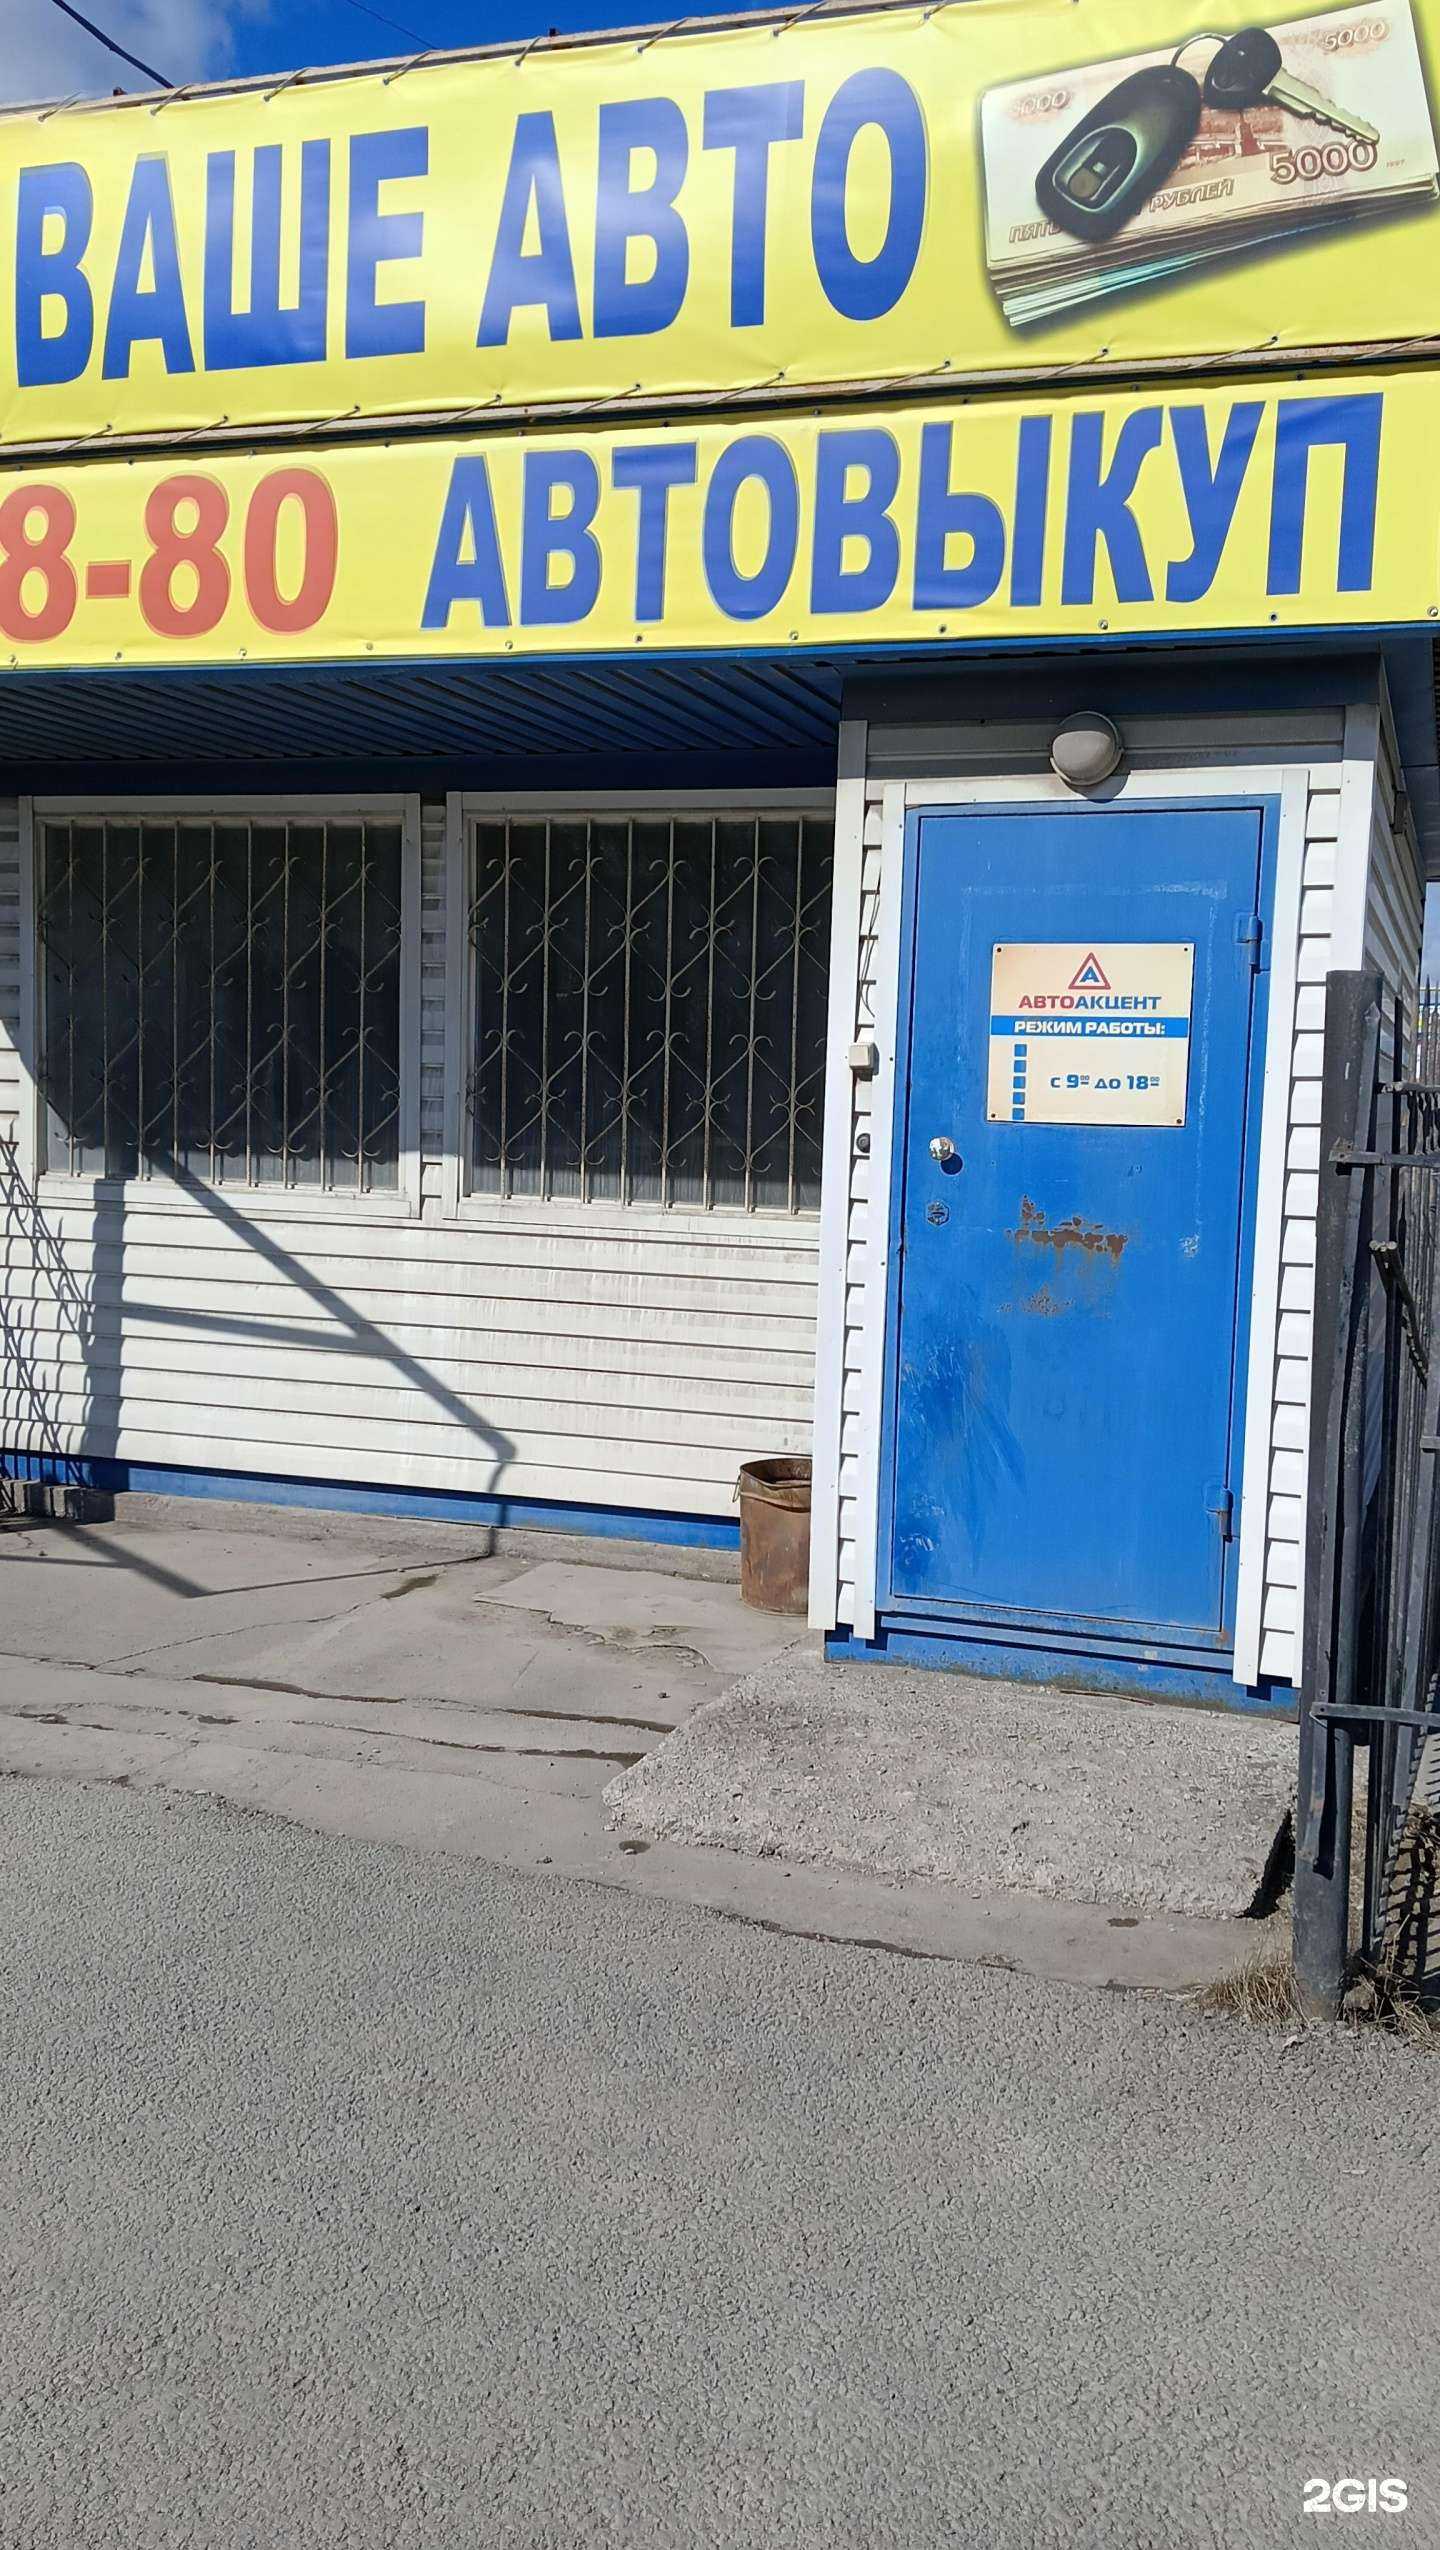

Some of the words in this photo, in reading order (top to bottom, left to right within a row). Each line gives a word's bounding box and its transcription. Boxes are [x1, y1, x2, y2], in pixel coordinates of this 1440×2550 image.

[1269, 141, 1378, 185] 5000
[1149, 177, 1234, 212] РУБЛЕЙ
[15, 126, 429, 388] ВАШЕ
[476, 66, 928, 348] АВТО
[420, 391, 1384, 631] АВТОВЫКУП
[1018, 995, 1162, 1010] АВТОАКЦЕНТ
[1014, 1021, 1082, 1034] РЕЖИМ
[1085, 1021, 1166, 1035] РАБОТЫ:
